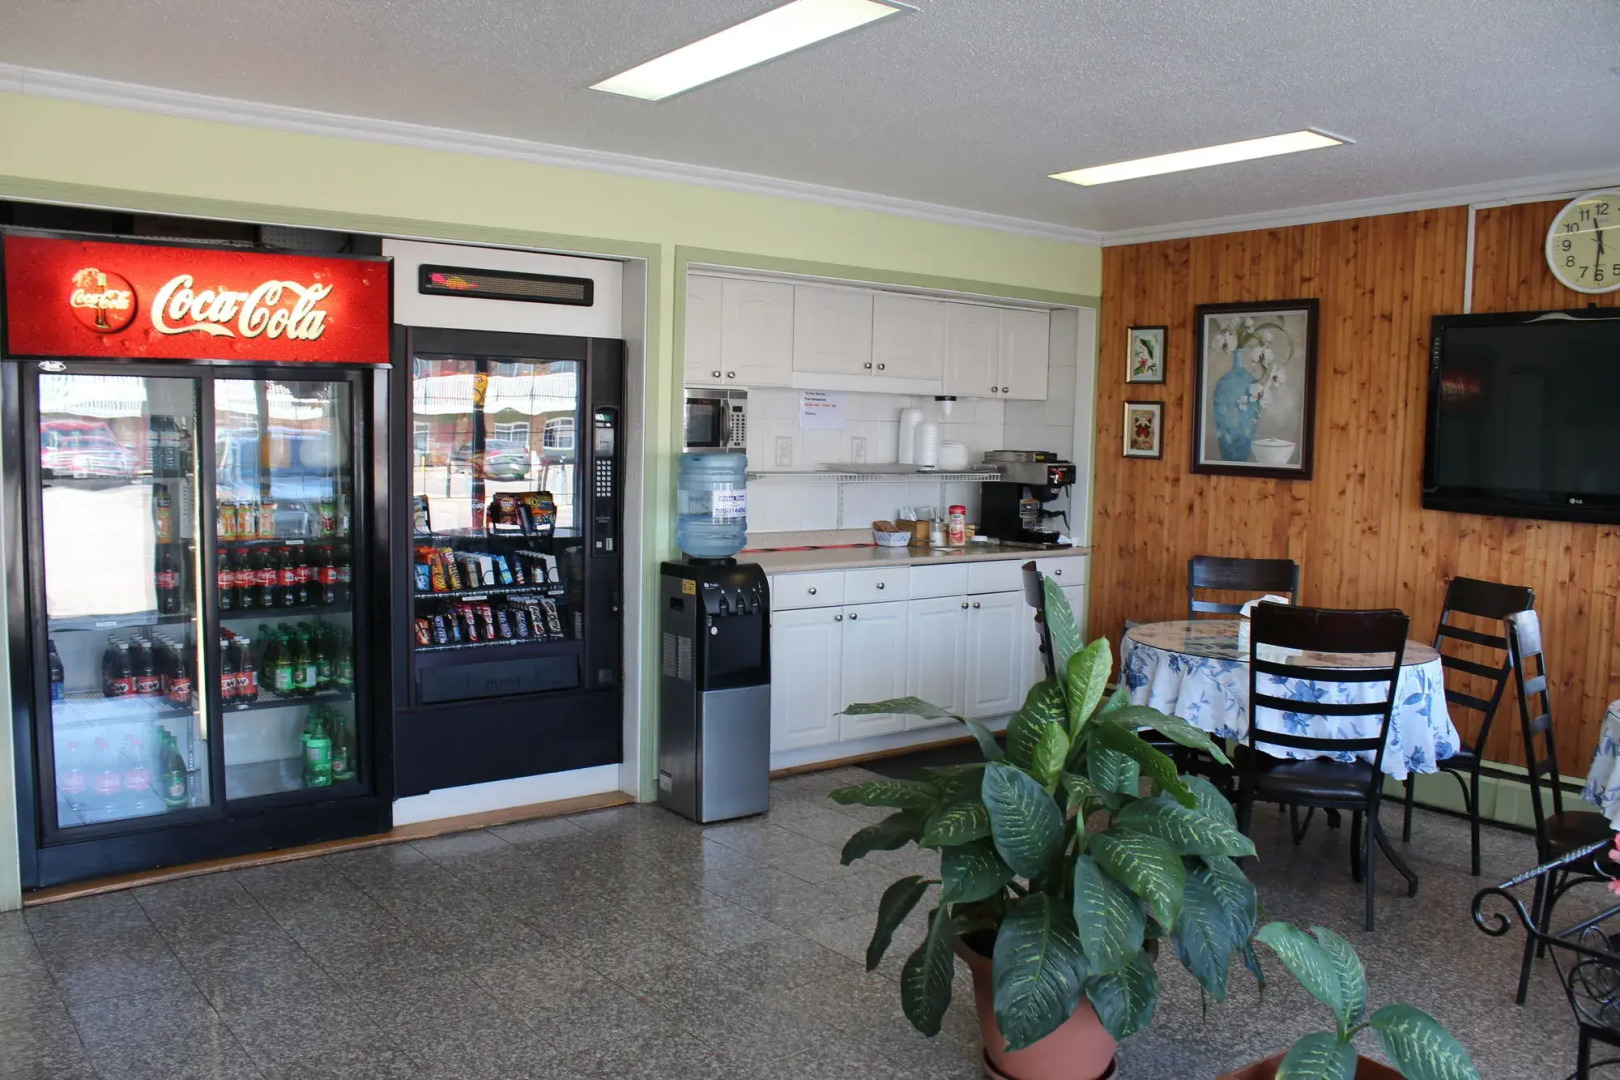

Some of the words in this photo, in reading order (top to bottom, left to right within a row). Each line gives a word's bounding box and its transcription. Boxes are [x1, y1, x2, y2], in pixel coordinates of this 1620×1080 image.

[1579, 209, 1590, 222] 11
[1595, 203, 1609, 215] 12
[1563, 222, 1580, 233] 10
[1562, 239, 1572, 252] 9
[1565, 255, 1575, 268] 8
[1579, 266, 1589, 278] 7
[1594, 269, 1604, 282] 6
[70, 288, 132, 310] Coca-Cola
[151, 274, 334, 341] Coca-Cola
